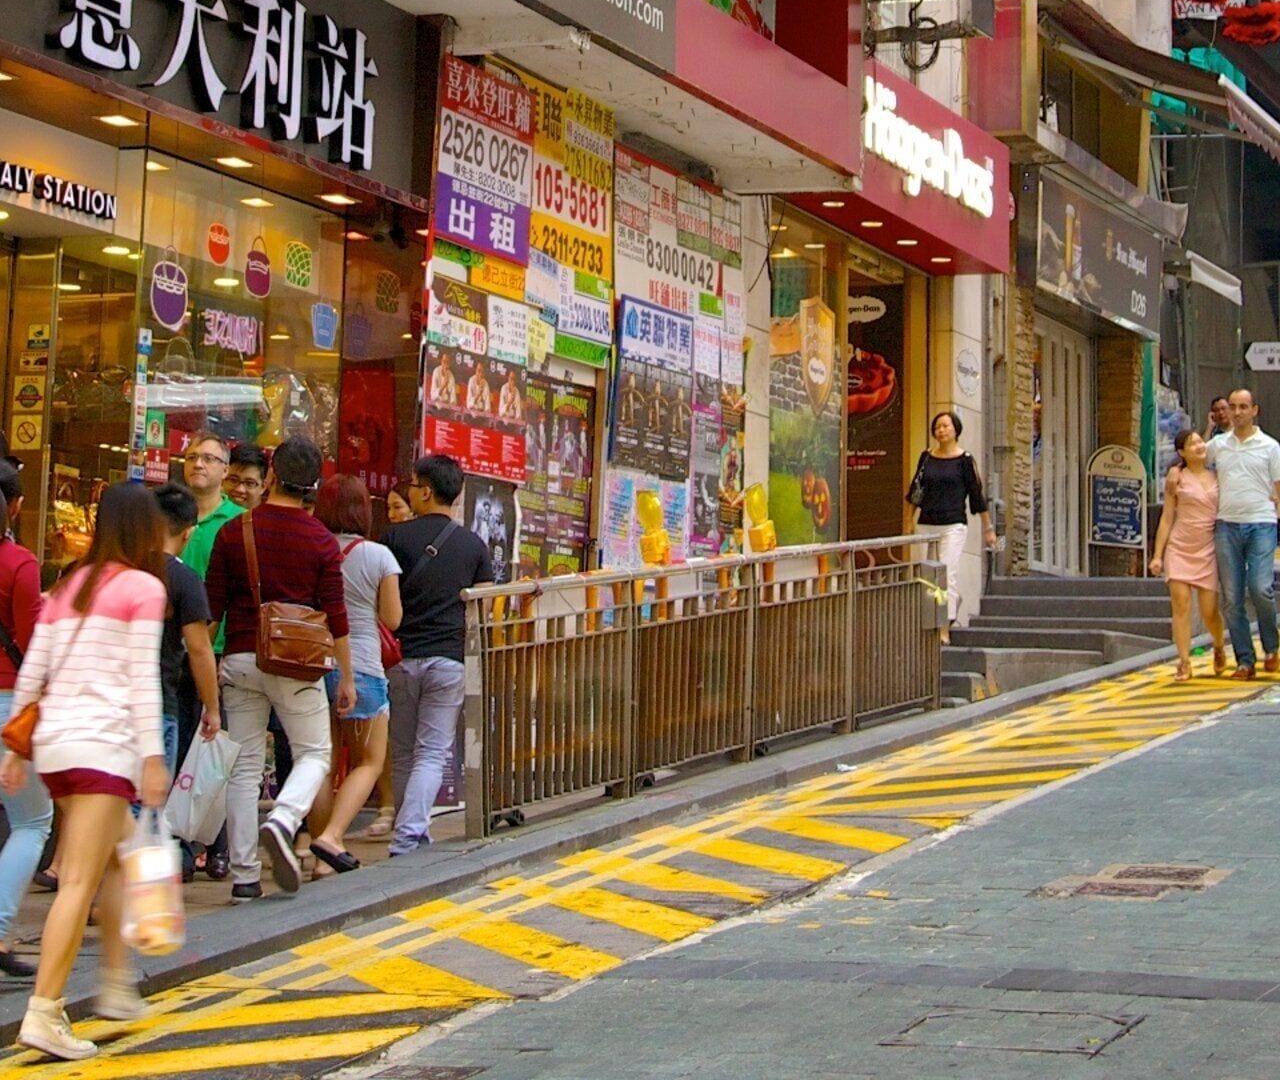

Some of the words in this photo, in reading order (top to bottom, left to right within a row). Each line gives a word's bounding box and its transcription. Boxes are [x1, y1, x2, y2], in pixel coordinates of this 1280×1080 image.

[441, 114, 486, 168] 2526
[487, 134, 529, 186] 0267
[43, 173, 118, 220] STATION
[447, 197, 517, 255] 出租
[542, 224, 604, 276] 2311-2733
[1131, 289, 1147, 317] D26
[1253, 345, 1268, 355] Lan
